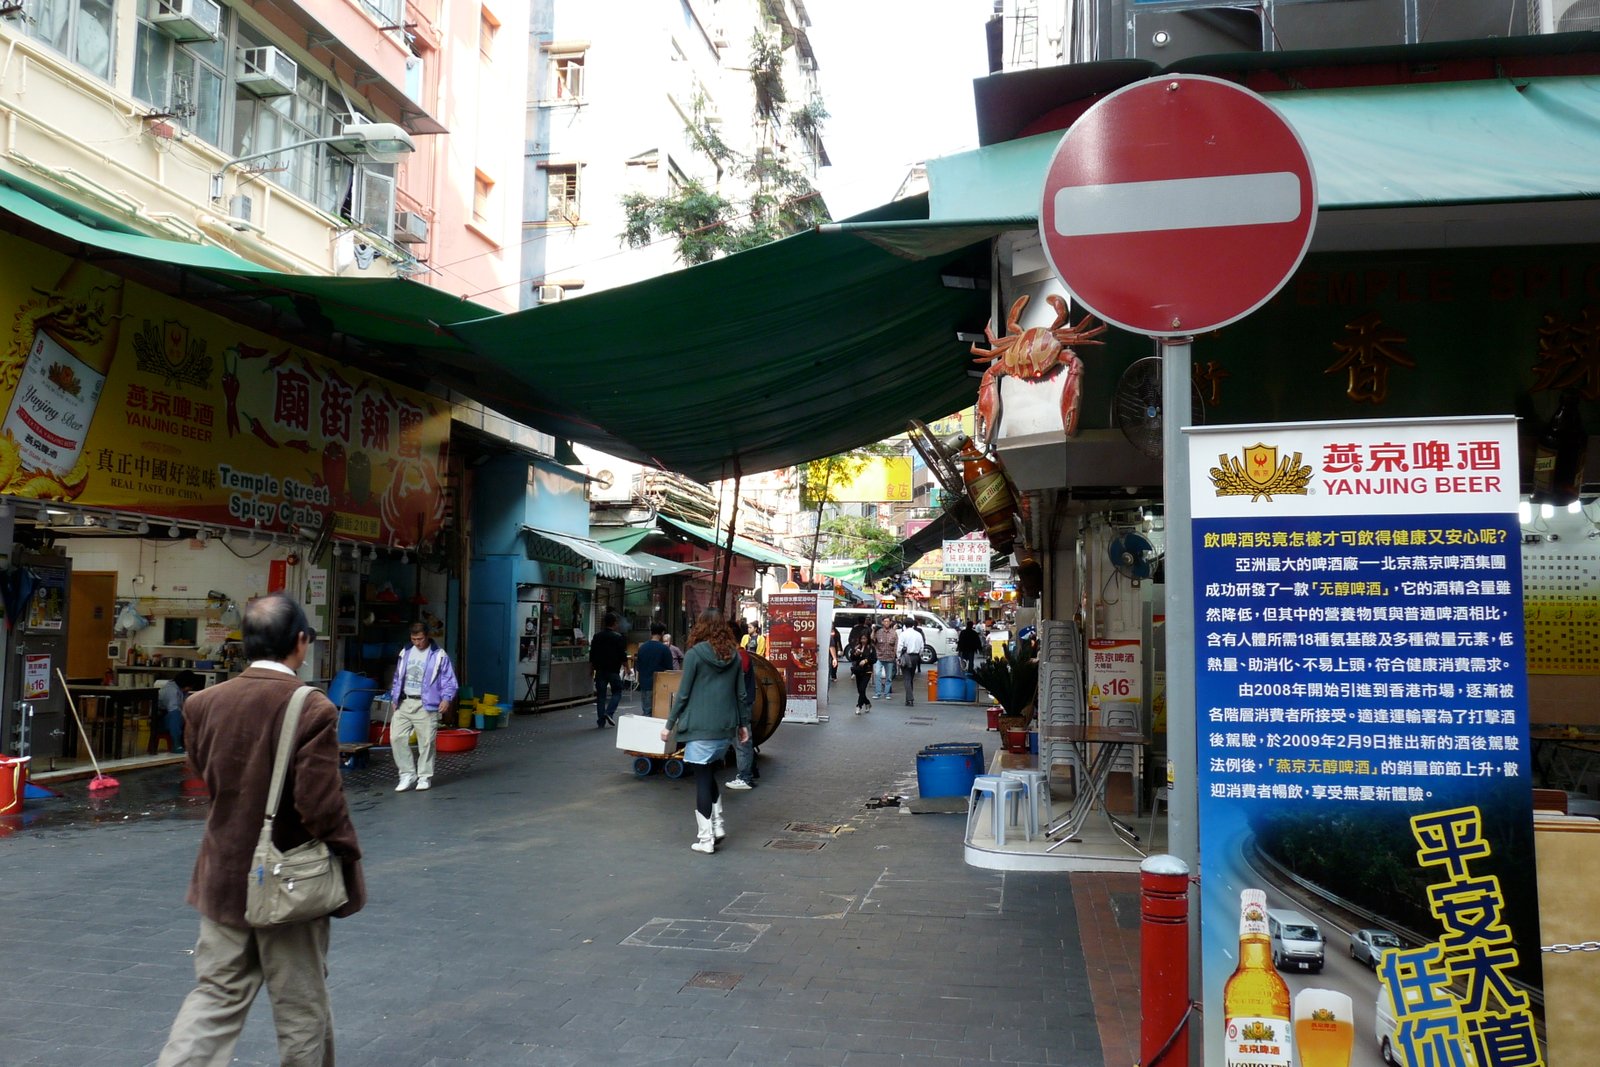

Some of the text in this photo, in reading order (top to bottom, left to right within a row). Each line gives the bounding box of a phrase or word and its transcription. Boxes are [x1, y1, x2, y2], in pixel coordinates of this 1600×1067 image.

[1269, 267, 1457, 306] EMPLE
[125, 383, 215, 428] 燕京啤酒
[125, 410, 213, 442] YANJING BEER
[1322, 440, 1501, 473] 燕京啤酒
[96, 448, 217, 491] 真正中國好滋味
[111, 477, 134, 490] REAL
[138, 482, 164, 495] TASTE
[165, 486, 176, 497] OF
[219, 466, 329, 503] Temple Street
[1322, 475, 1502, 496] YANJING BEER
[230, 496, 322, 527] Spicy Crabs
[793, 619, 815, 632] $99
[769, 653, 788, 661] $148
[1094, 652, 1135, 663] 燕京啤酒
[31, 679, 45, 691] $16
[797, 684, 816, 692] $178
[1102, 678, 1130, 696] $16
[1238, 683, 1514, 698] 由2008年開始引進到香港市場，逐漸被
